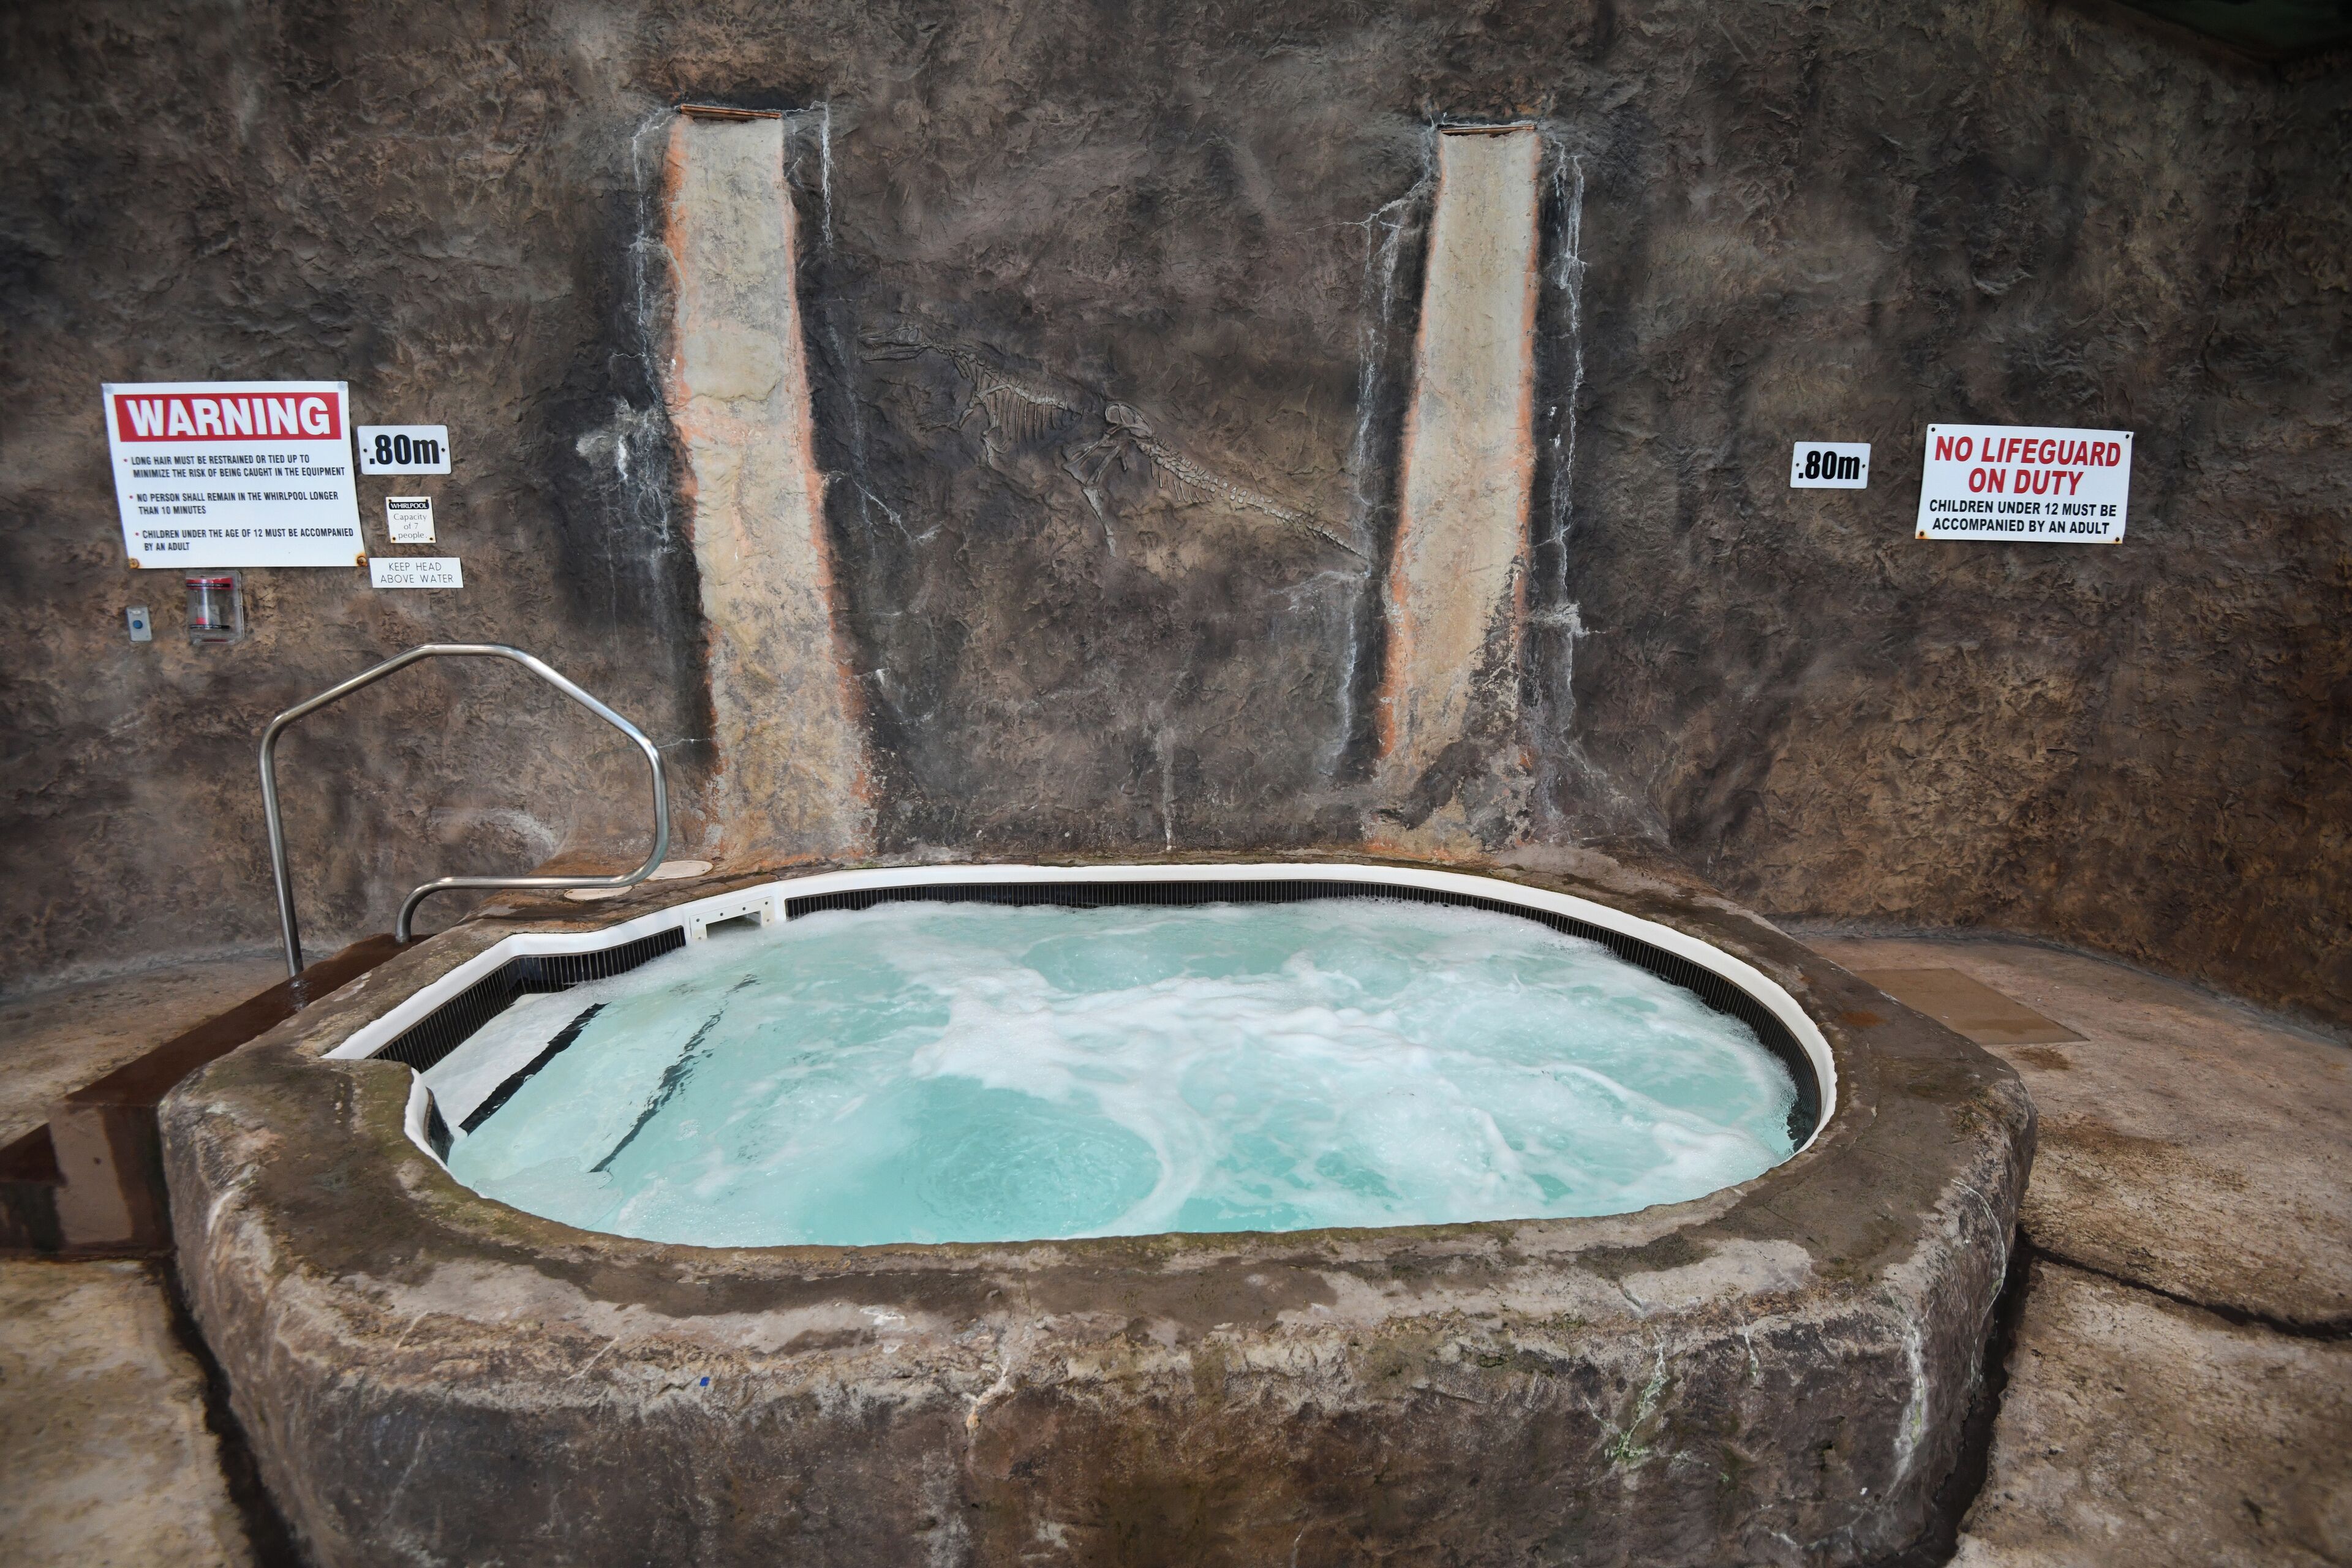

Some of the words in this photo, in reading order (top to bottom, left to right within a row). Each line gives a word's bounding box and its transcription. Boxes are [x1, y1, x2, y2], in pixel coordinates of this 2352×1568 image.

[126, 398, 331, 437] WARNING
[369, 434, 440, 465] .80m
[1935, 435, 1973, 462] NO
[1981, 437, 2121, 467] LIFEGUARD
[131, 456, 151, 466] LONG
[153, 456, 172, 465] HAIR
[174, 456, 194, 465] MUST
[197, 456, 207, 464] BE
[209, 455, 254, 464] RESTRAINED
[255, 454, 266, 464] OR
[268, 454, 285, 464] TIED
[287, 454, 297, 464] UP
[300, 454, 309, 464] TO
[1798, 450, 1860, 480] .80m
[133, 469, 170, 478] MINIMIZE
[172, 469, 187, 478] THE
[189, 469, 206, 477] RISK
[208, 468, 217, 477] OF
[219, 468, 241, 477] BEING
[243, 467, 273, 477] CAUGHT
[274, 467, 283, 476] IN
[284, 467, 300, 476] THE
[301, 467, 345, 477] EQUIPMENT
[1969, 467, 2007, 493] ON
[2013, 469, 2084, 496] DUTY
[137, 493, 148, 502] NO
[150, 493, 180, 502] PERSON
[182, 493, 205, 502] SHALL
[207, 492, 236, 501] REMAIN
[238, 492, 246, 501] IN
[247, 492, 262, 501] THE
[263, 491, 308, 500] WHIRLPOOL
[309, 491, 339, 500] LONGER
[138, 506, 159, 514] THAN
[161, 506, 170, 514] 10
[173, 505, 206, 514] MINUTES
[1929, 499, 1994, 513] CHILDREN
[1997, 501, 2041, 514] UNDER
[2045, 502, 2059, 515] 12
[2062, 503, 2097, 517] MUST
[2100, 504, 2117, 517] BE
[394, 513, 427, 522] Capacity
[1932, 518, 2024, 532] ACCOMPANIED
[2029, 520, 2045, 532] BY
[2048, 521, 2066, 533] AN
[2069, 521, 2110, 535] ADULT
[143, 530, 179, 539] CHILDREN
[182, 529, 206, 538] UNDER
[208, 529, 223, 538] THE
[225, 529, 239, 538] AGE
[241, 529, 251, 538] OF
[254, 529, 263, 537] 12
[265, 528, 285, 537] MUST
[288, 528, 298, 537] BE
[300, 528, 353, 537] ACCOMPANIED
[398, 532, 428, 540] people.
[144, 543, 153, 551] BY
[168, 542, 190, 551] ADULT
[389, 562, 410, 571] KEEP
[415, 562, 442, 571] HEAD
[380, 575, 415, 583] ABOVE
[420, 575, 454, 583] WATER
